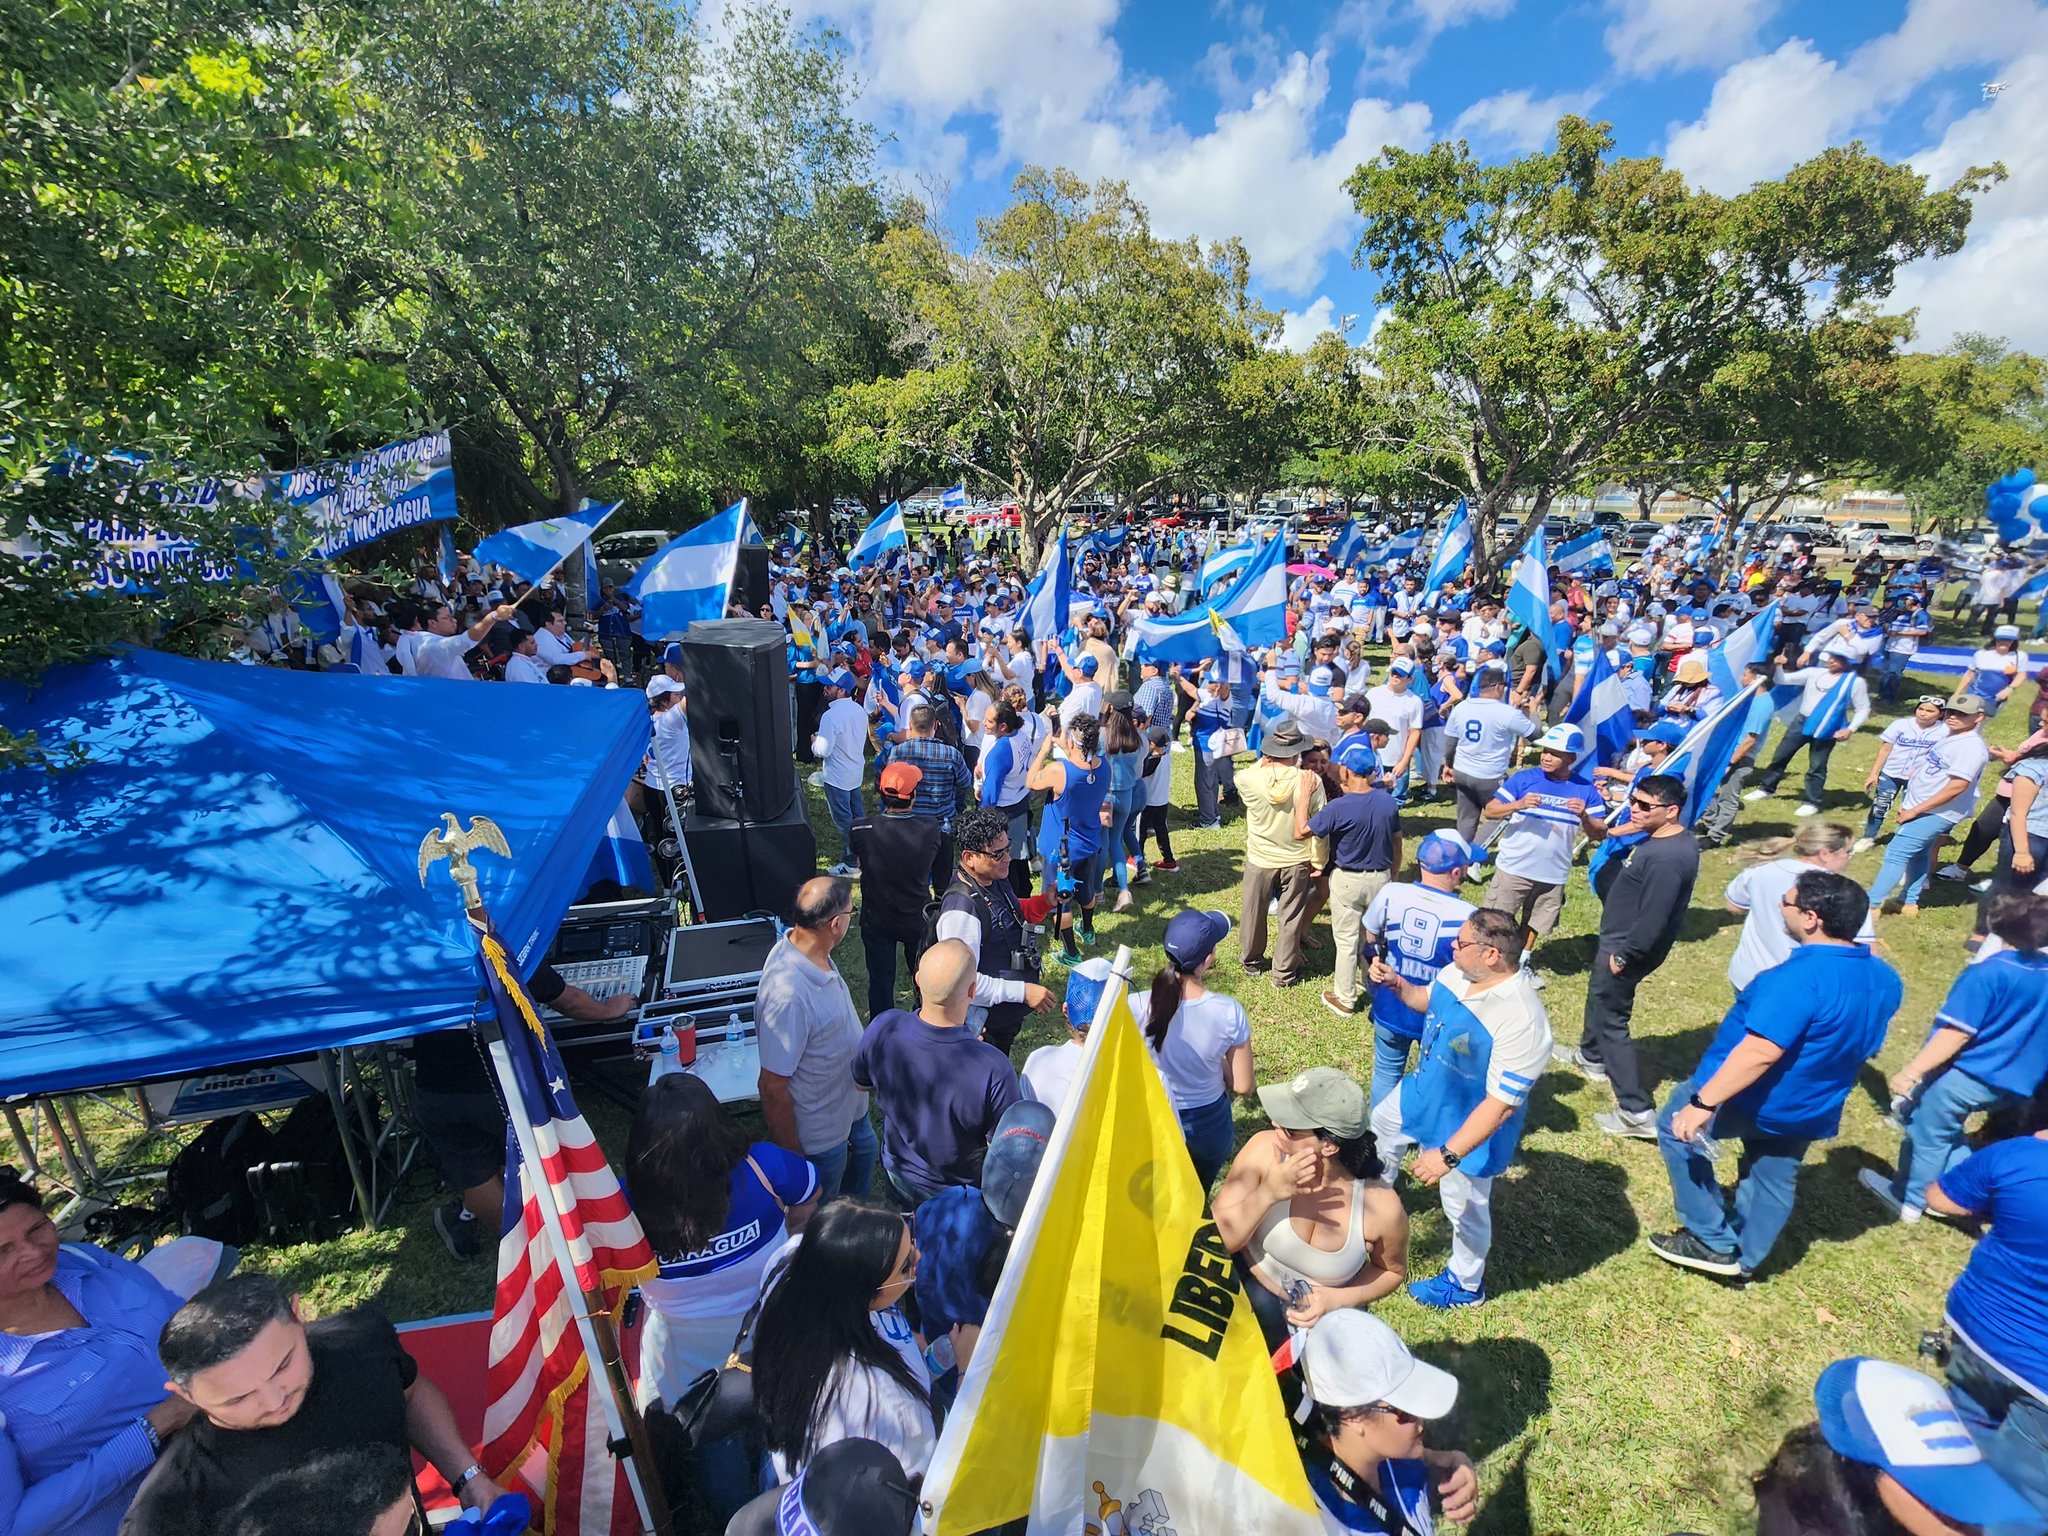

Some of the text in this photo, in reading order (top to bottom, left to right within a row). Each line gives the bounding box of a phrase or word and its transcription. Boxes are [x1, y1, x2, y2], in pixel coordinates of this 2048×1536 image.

[325, 493, 340, 521] Y
[352, 495, 433, 543] NICARAGUA
[1465, 719, 1482, 743] 8
[1401, 906, 1440, 960] 9
[1330, 1461, 1354, 1490] PINK
[1369, 1498, 1387, 1521] PINK
